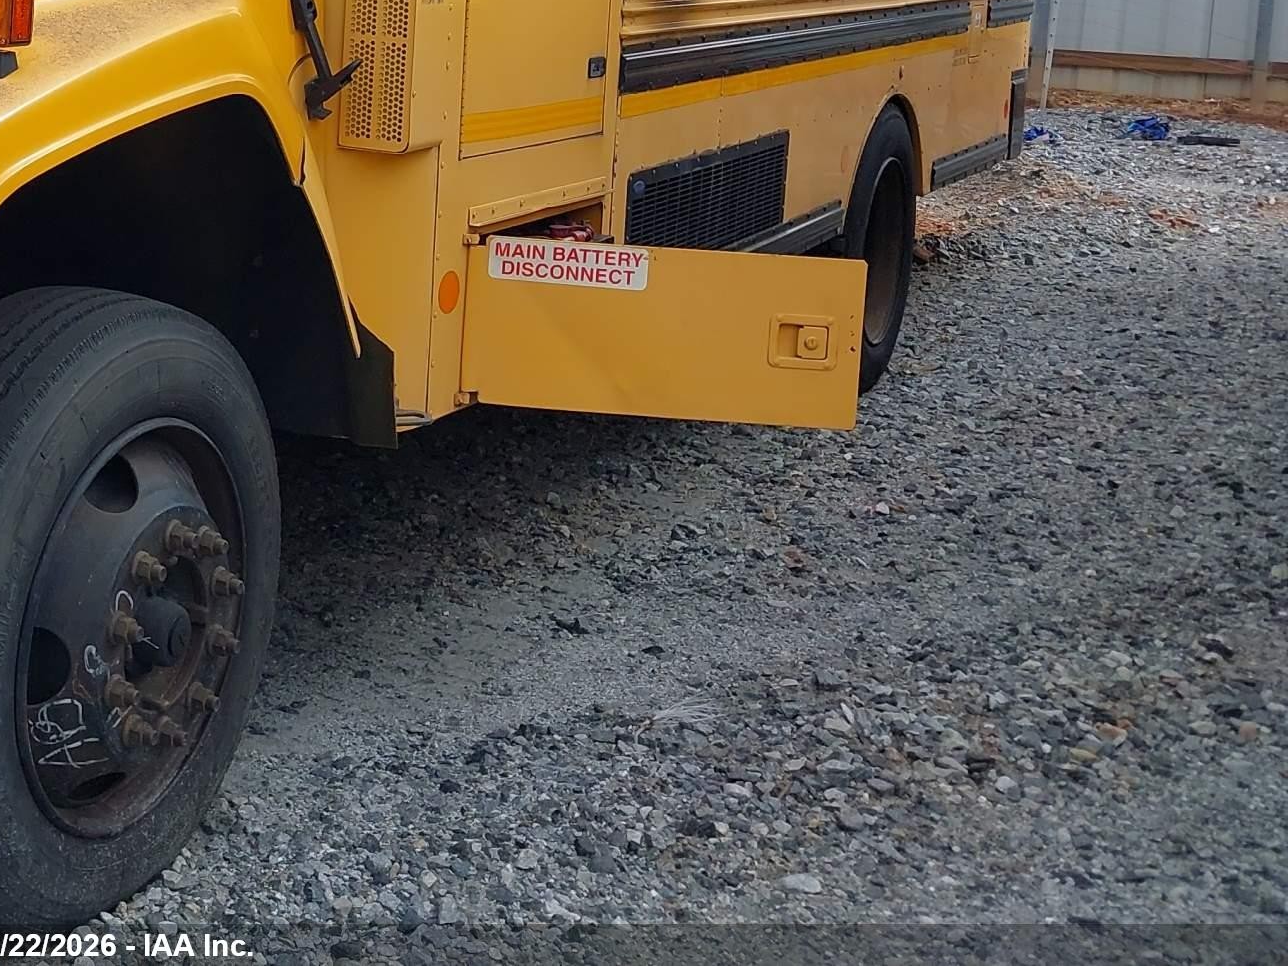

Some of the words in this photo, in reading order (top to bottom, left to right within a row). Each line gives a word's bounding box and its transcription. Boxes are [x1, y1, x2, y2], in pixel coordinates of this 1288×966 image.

[494, 242, 546, 260] MAIN
[552, 246, 643, 268] BATTERY
[501, 260, 635, 285] DISCONNECT
